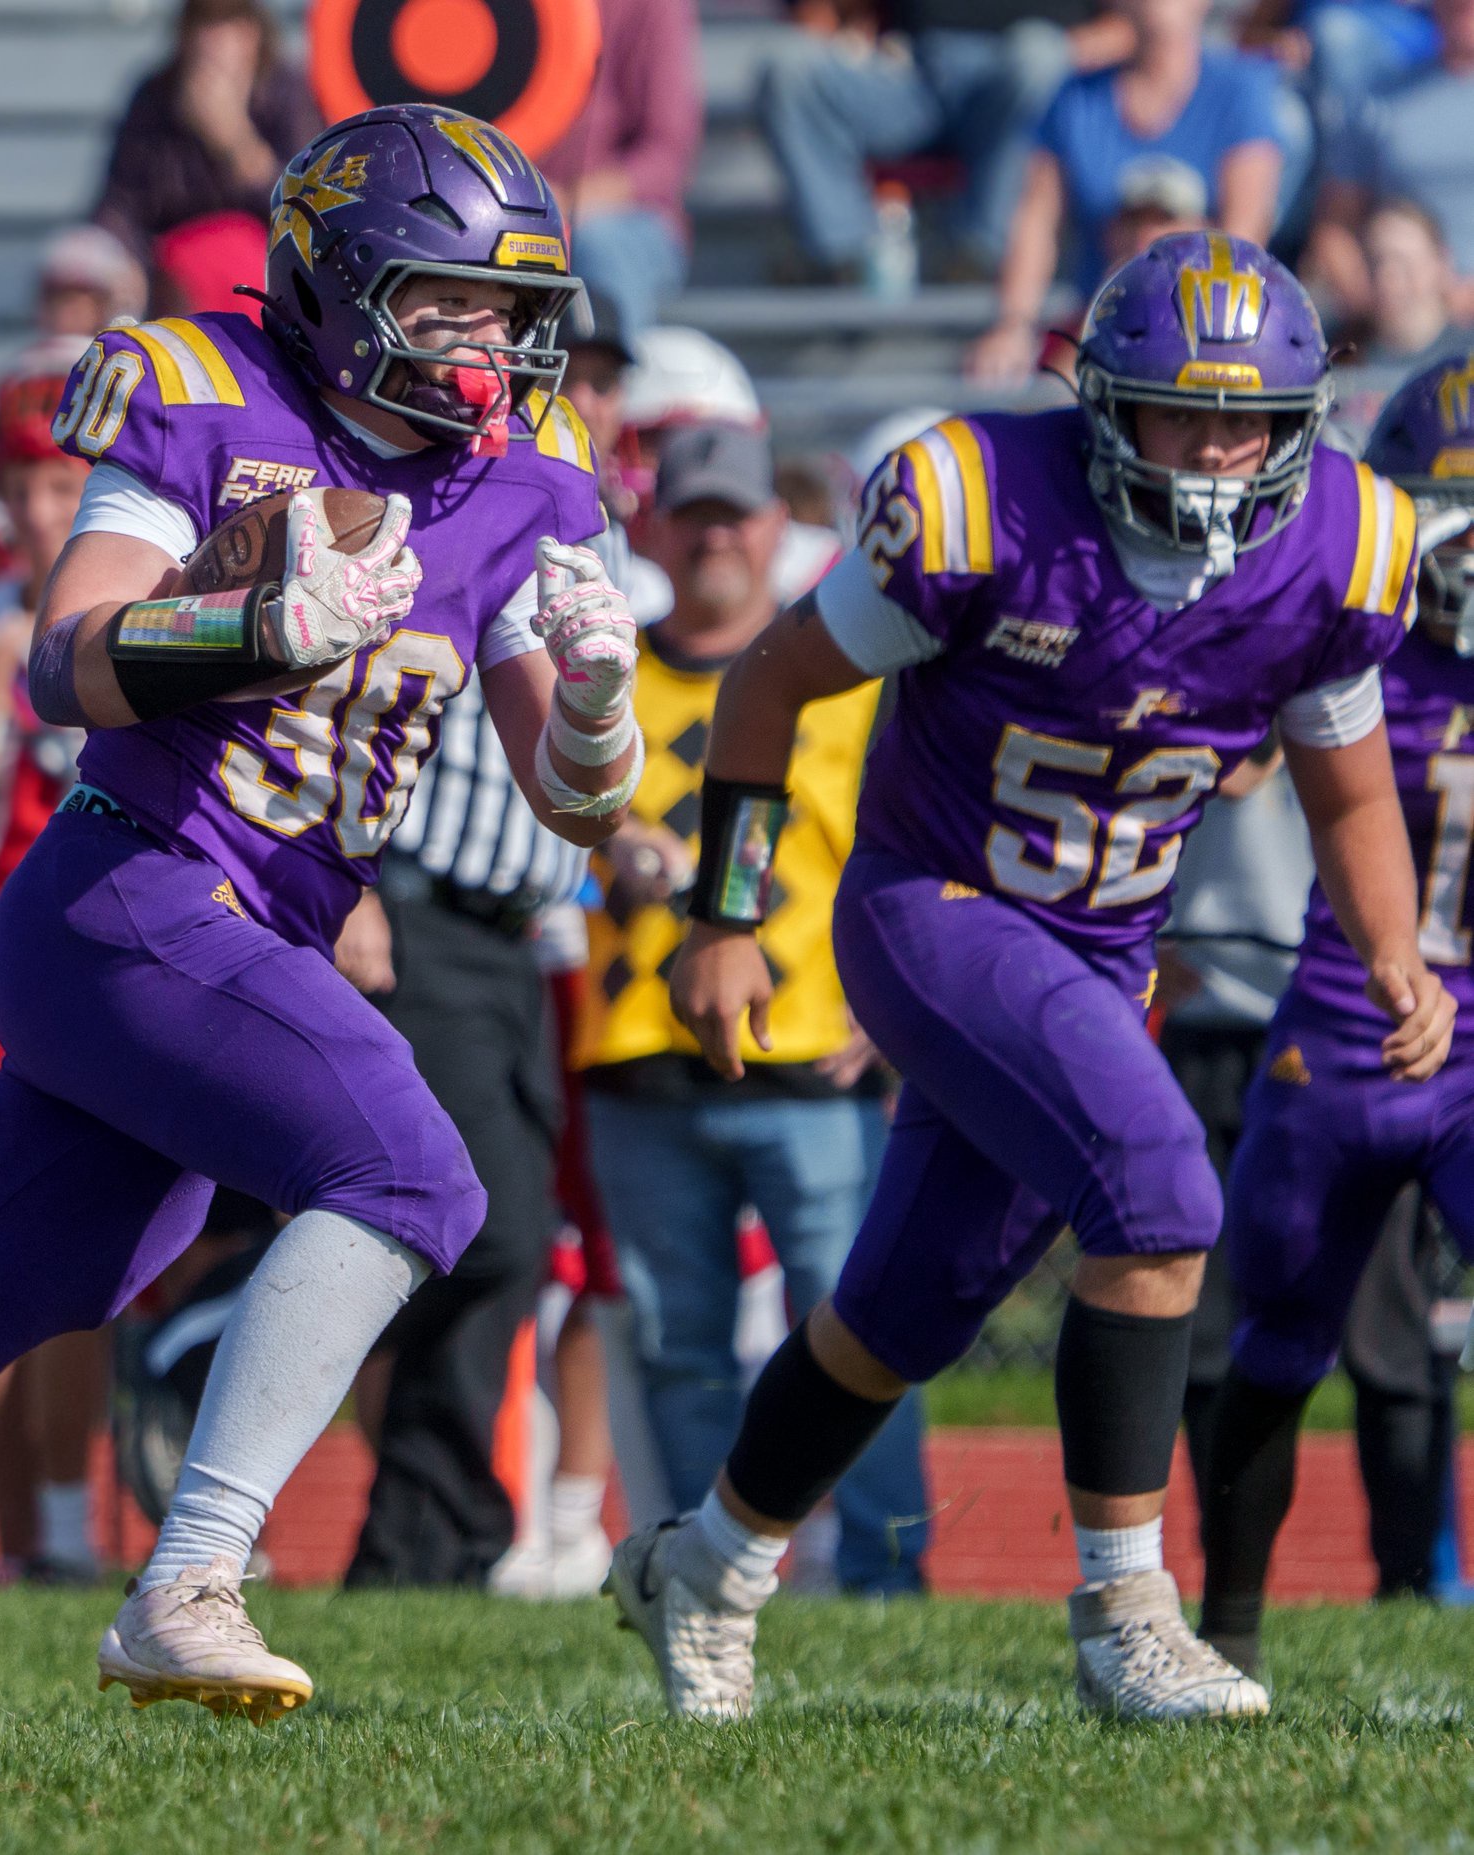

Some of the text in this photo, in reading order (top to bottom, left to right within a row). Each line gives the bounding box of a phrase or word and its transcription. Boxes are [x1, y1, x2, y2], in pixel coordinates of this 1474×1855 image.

[509, 240, 560, 257] SILVERBACK
[51, 341, 145, 458] 30
[227, 456, 318, 488] FEAR
[218, 629, 465, 859] 30
[986, 723, 1223, 909] 52
